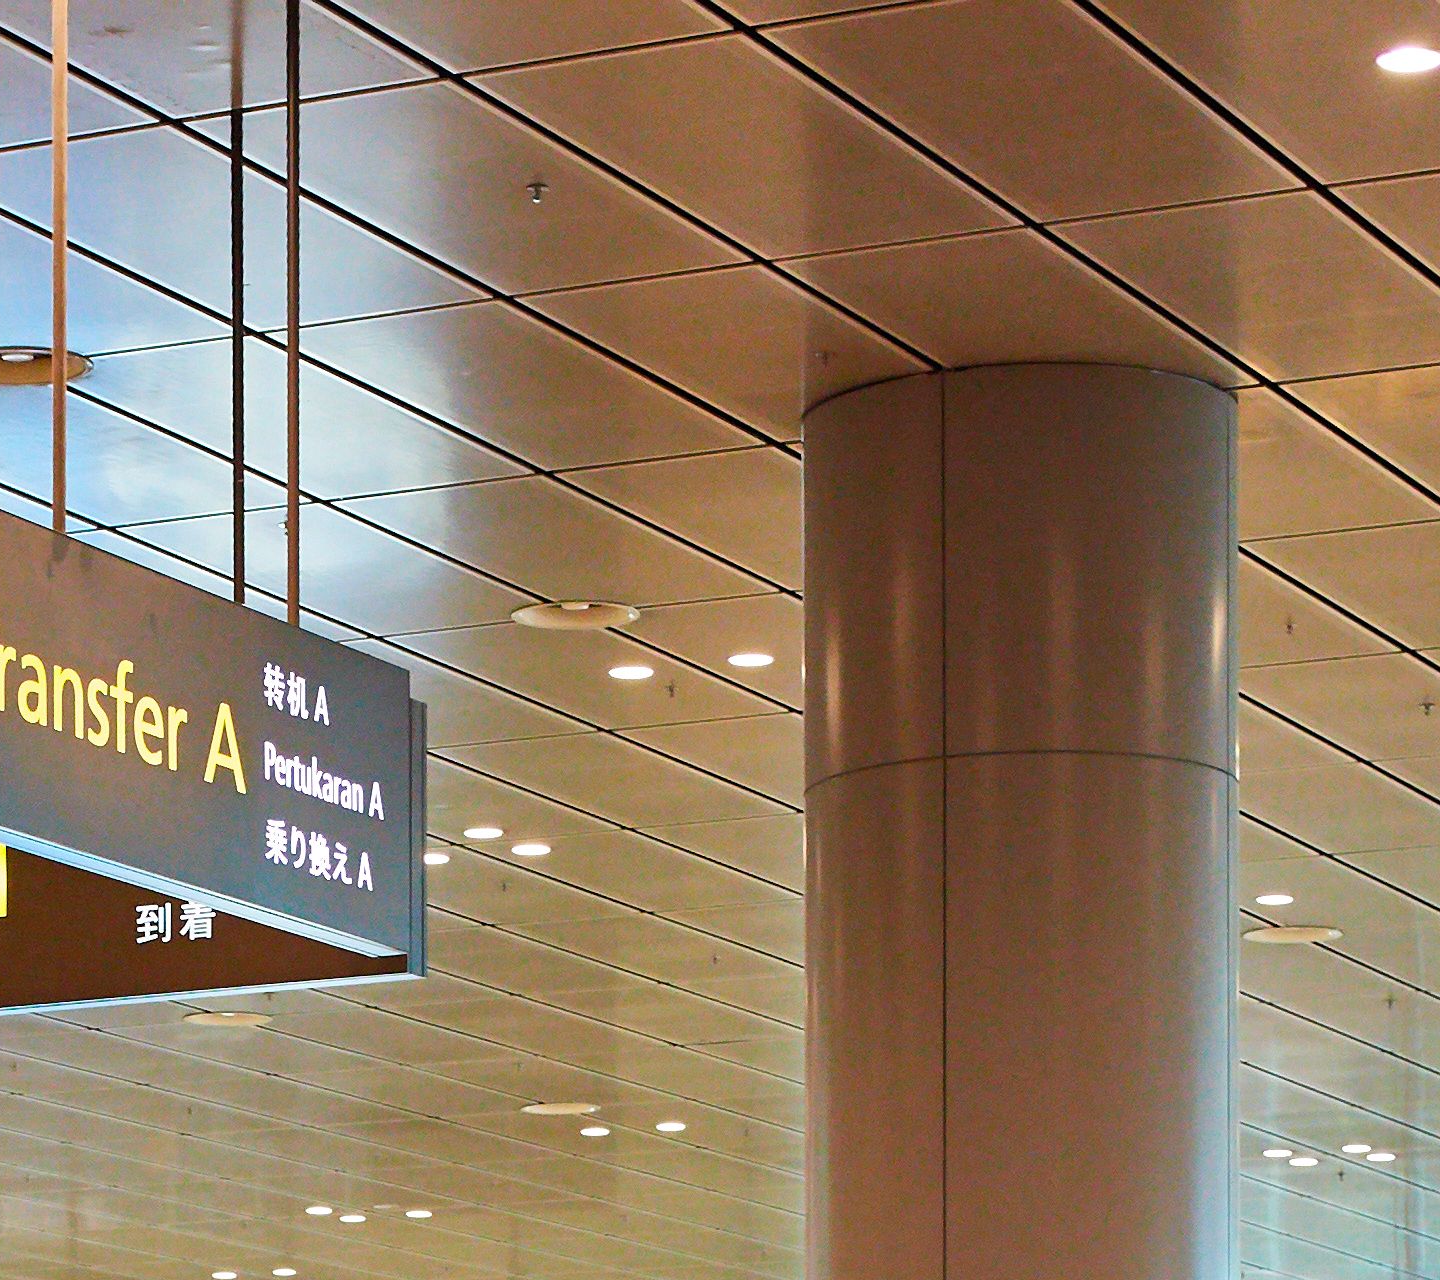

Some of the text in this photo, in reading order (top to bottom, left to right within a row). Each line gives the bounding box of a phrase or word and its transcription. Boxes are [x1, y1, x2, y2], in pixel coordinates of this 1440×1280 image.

[262, 661, 330, 727] 转机 A
[204, 701, 247, 796] A
[263, 740, 385, 821] Pertukaran A
[263, 818, 373, 892] 乗り換え A
[135, 902, 216, 946] 到着
